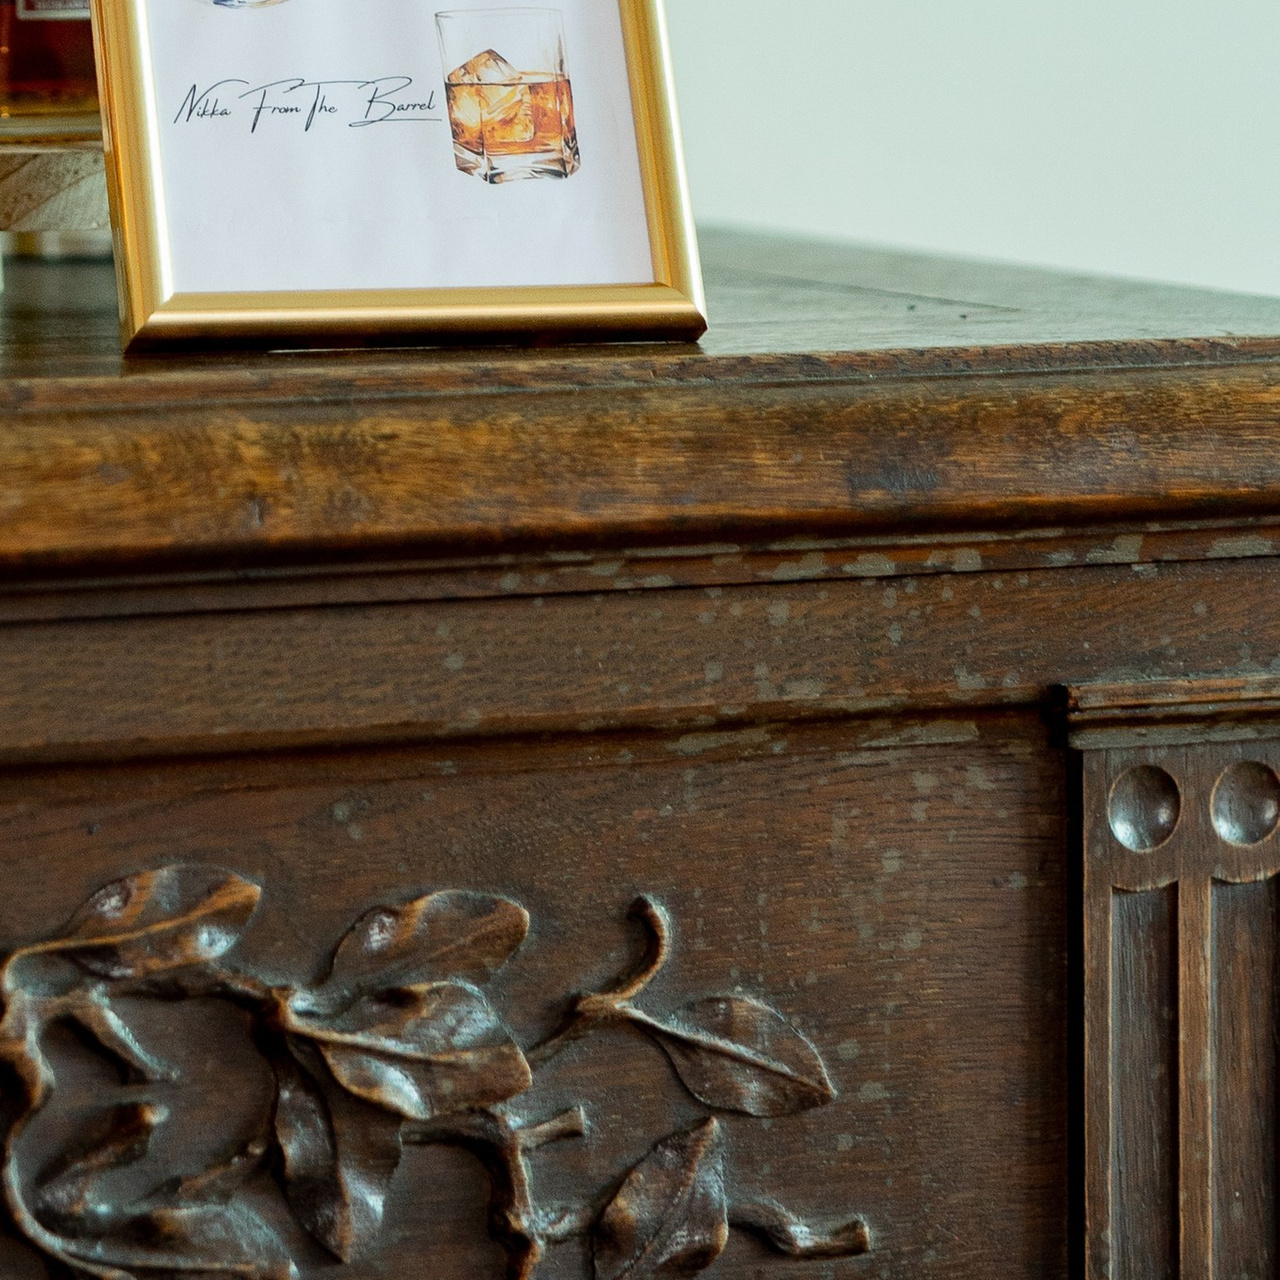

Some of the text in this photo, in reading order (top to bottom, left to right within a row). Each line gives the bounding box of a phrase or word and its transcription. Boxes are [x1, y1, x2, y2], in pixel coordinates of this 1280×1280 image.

[173, 78, 250, 125] Nikka
[238, 77, 305, 134] From
[348, 76, 443, 128] Barrel
